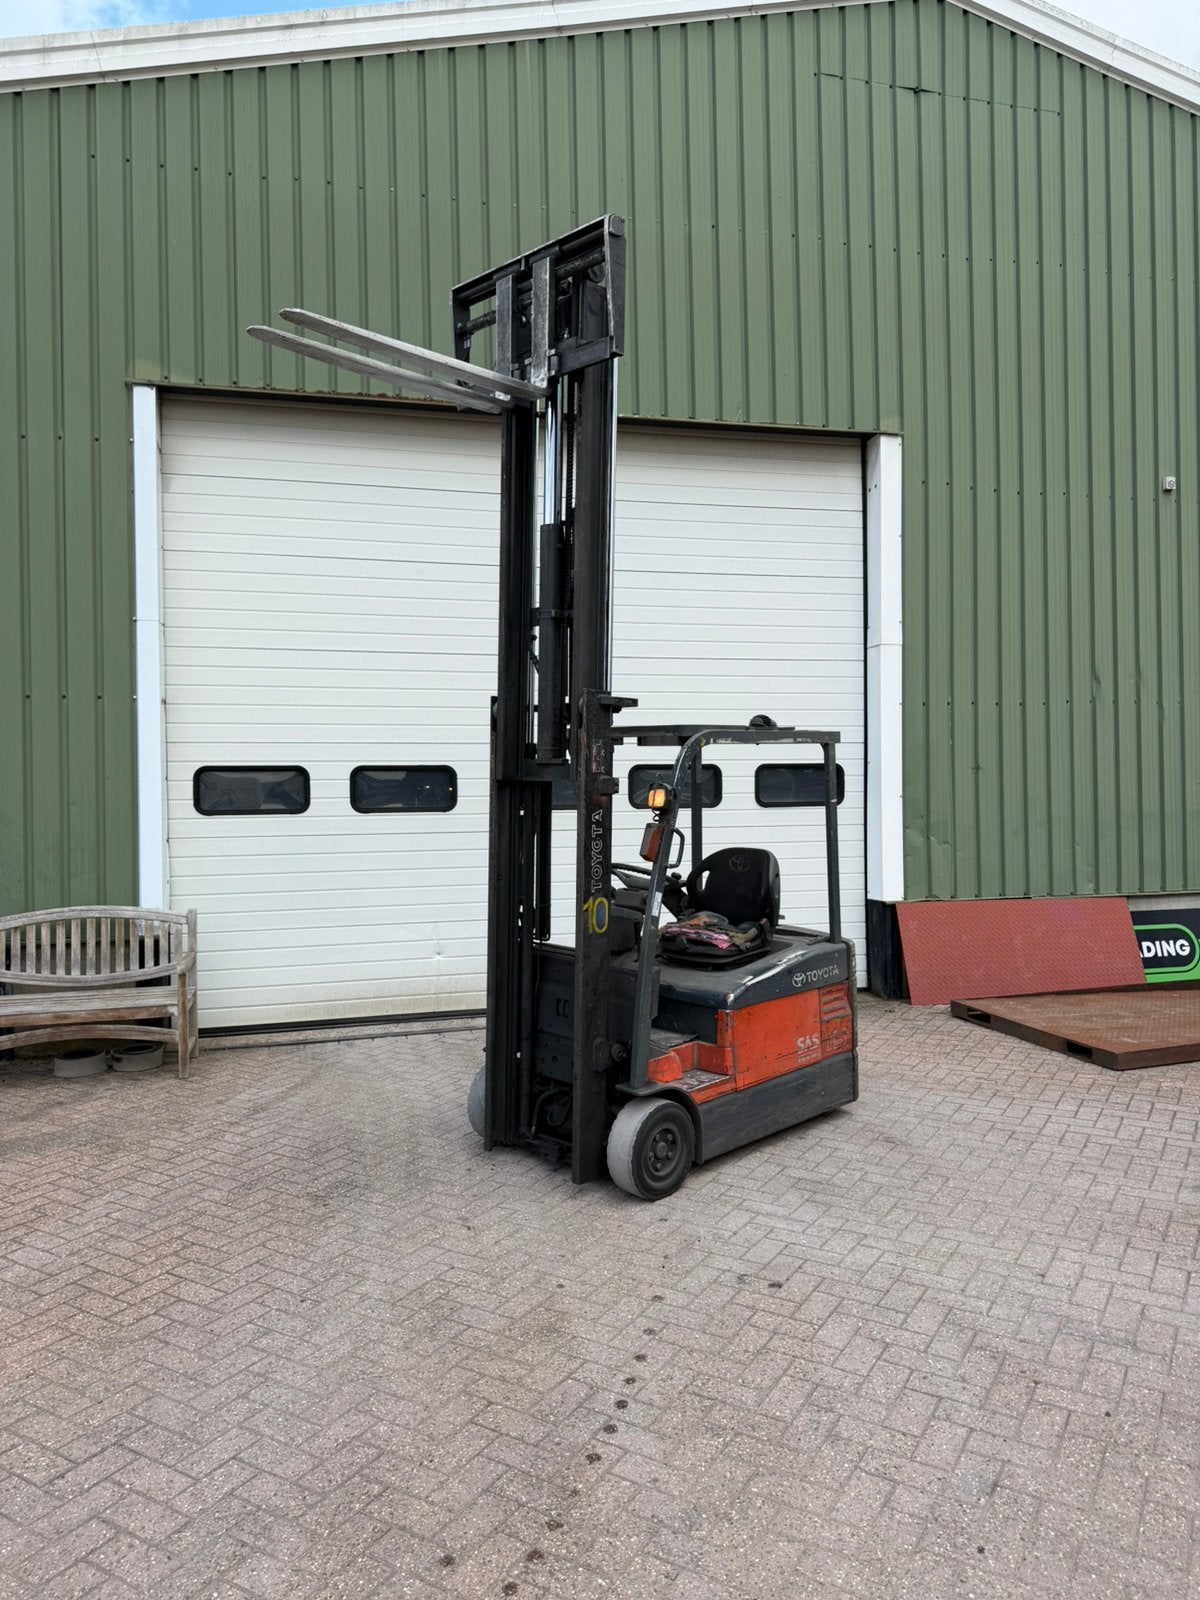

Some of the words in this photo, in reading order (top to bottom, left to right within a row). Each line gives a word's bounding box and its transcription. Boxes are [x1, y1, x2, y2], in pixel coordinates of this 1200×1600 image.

[591, 809, 603, 893] TOYOTA
[582, 896, 609, 934] 10
[806, 964, 840, 983] TOYOTA
[796, 1031, 820, 1049] SAS
